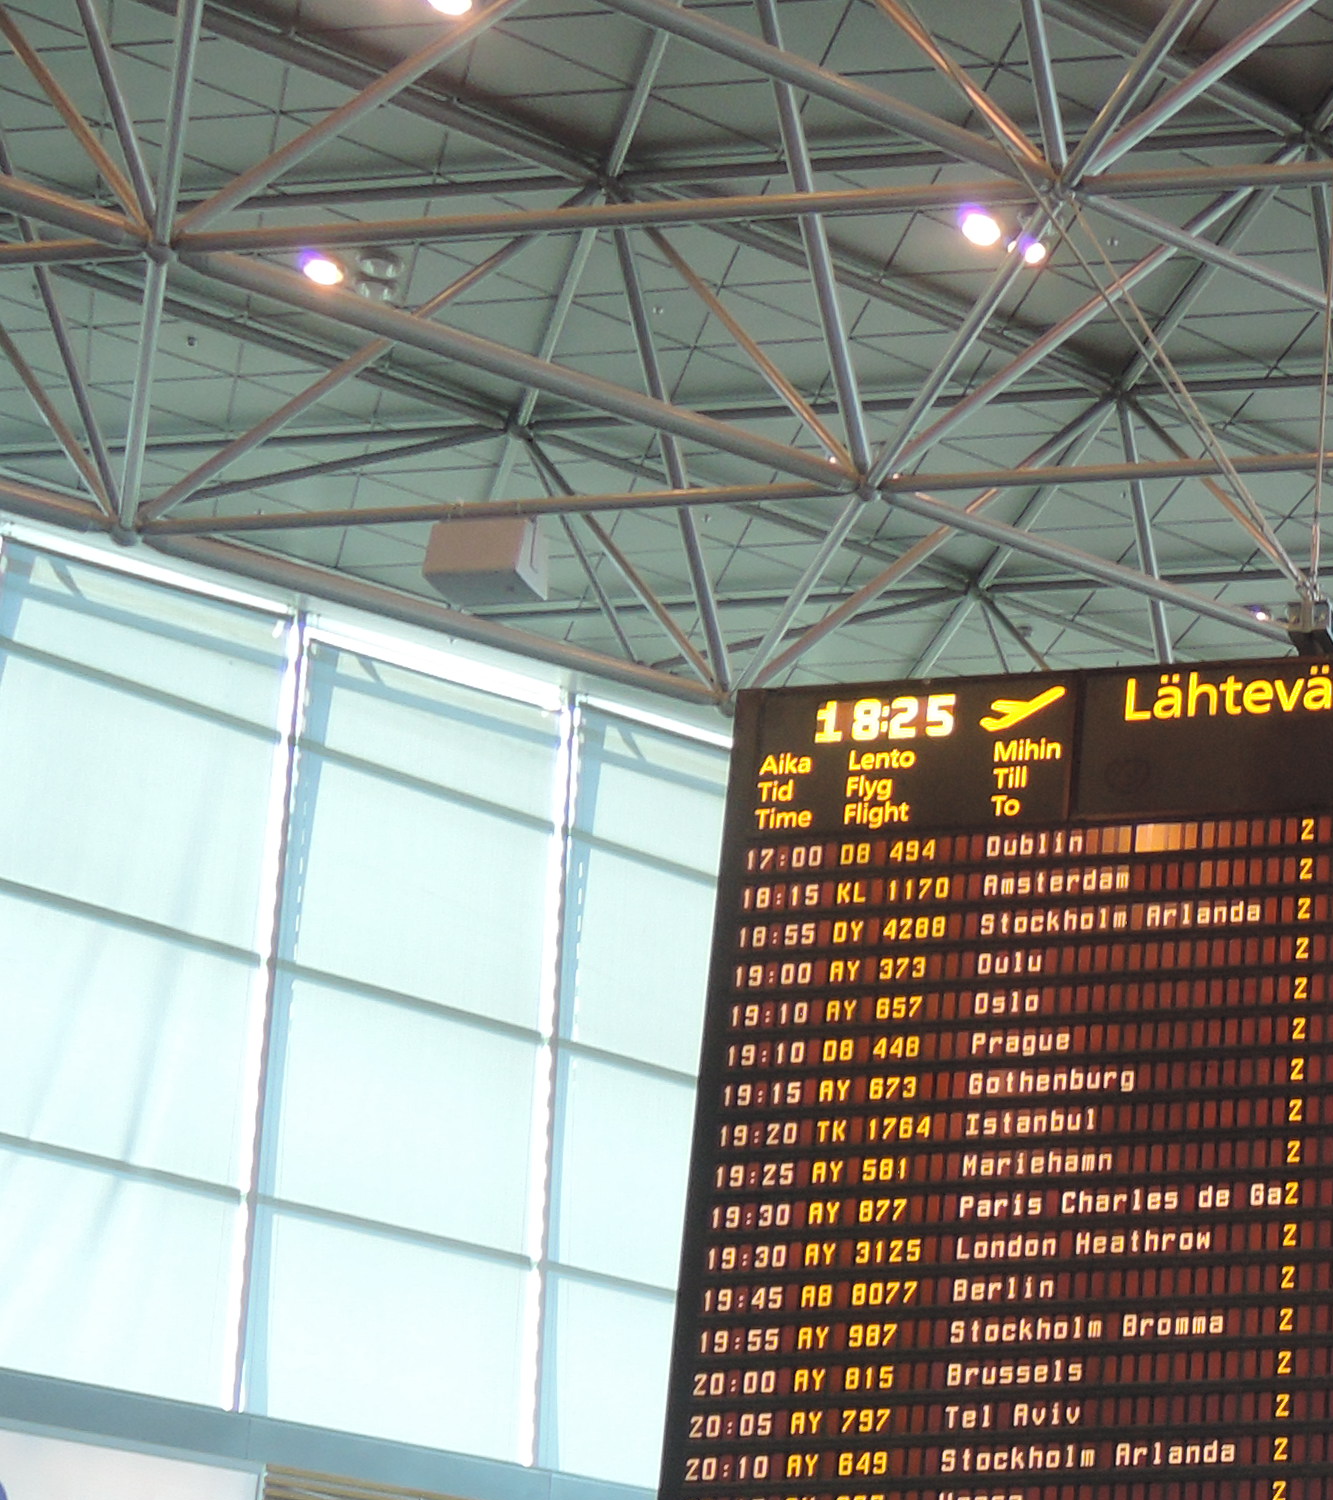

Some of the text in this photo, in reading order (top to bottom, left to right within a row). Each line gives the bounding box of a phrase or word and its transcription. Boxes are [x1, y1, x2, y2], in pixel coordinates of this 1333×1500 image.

[815, 694, 955, 743] 18:25
[849, 749, 915, 770] Lento
[994, 738, 1060, 761] Mihin
[760, 753, 811, 775] Aika
[847, 775, 892, 801] Flyg
[993, 766, 1027, 789] Till
[758, 779, 793, 802] Tid
[844, 801, 909, 828] Flight
[991, 795, 1020, 816] To
[755, 808, 812, 829] Time
[987, 833, 1082, 856] Dublin
[984, 869, 1129, 896] Amsterdam
[981, 901, 1260, 934] Stockholm Arlanda
[978, 952, 1041, 974] Oulu
[975, 992, 1038, 1014] Oslo
[972, 1033, 1069, 1056] Prague
[969, 1069, 1134, 1094] Gothenburg
[966, 1109, 1093, 1135] Istanbul
[963, 1151, 1111, 1176] Mariehamn
[960, 1194, 1041, 1217] Paris
[1062, 1189, 1177, 1213] Charles
[1199, 1186, 1229, 1207] de
[957, 1230, 1210, 1259] London Heathrow
[953, 1277, 1053, 1301] Berlin
[951, 1315, 1223, 1343] Stockholm Bromma
[947, 1360, 1081, 1386] Brussels
[946, 1403, 1080, 1428] Tel Aviv
[942, 1440, 1234, 1471] Stockholm Arlanda
